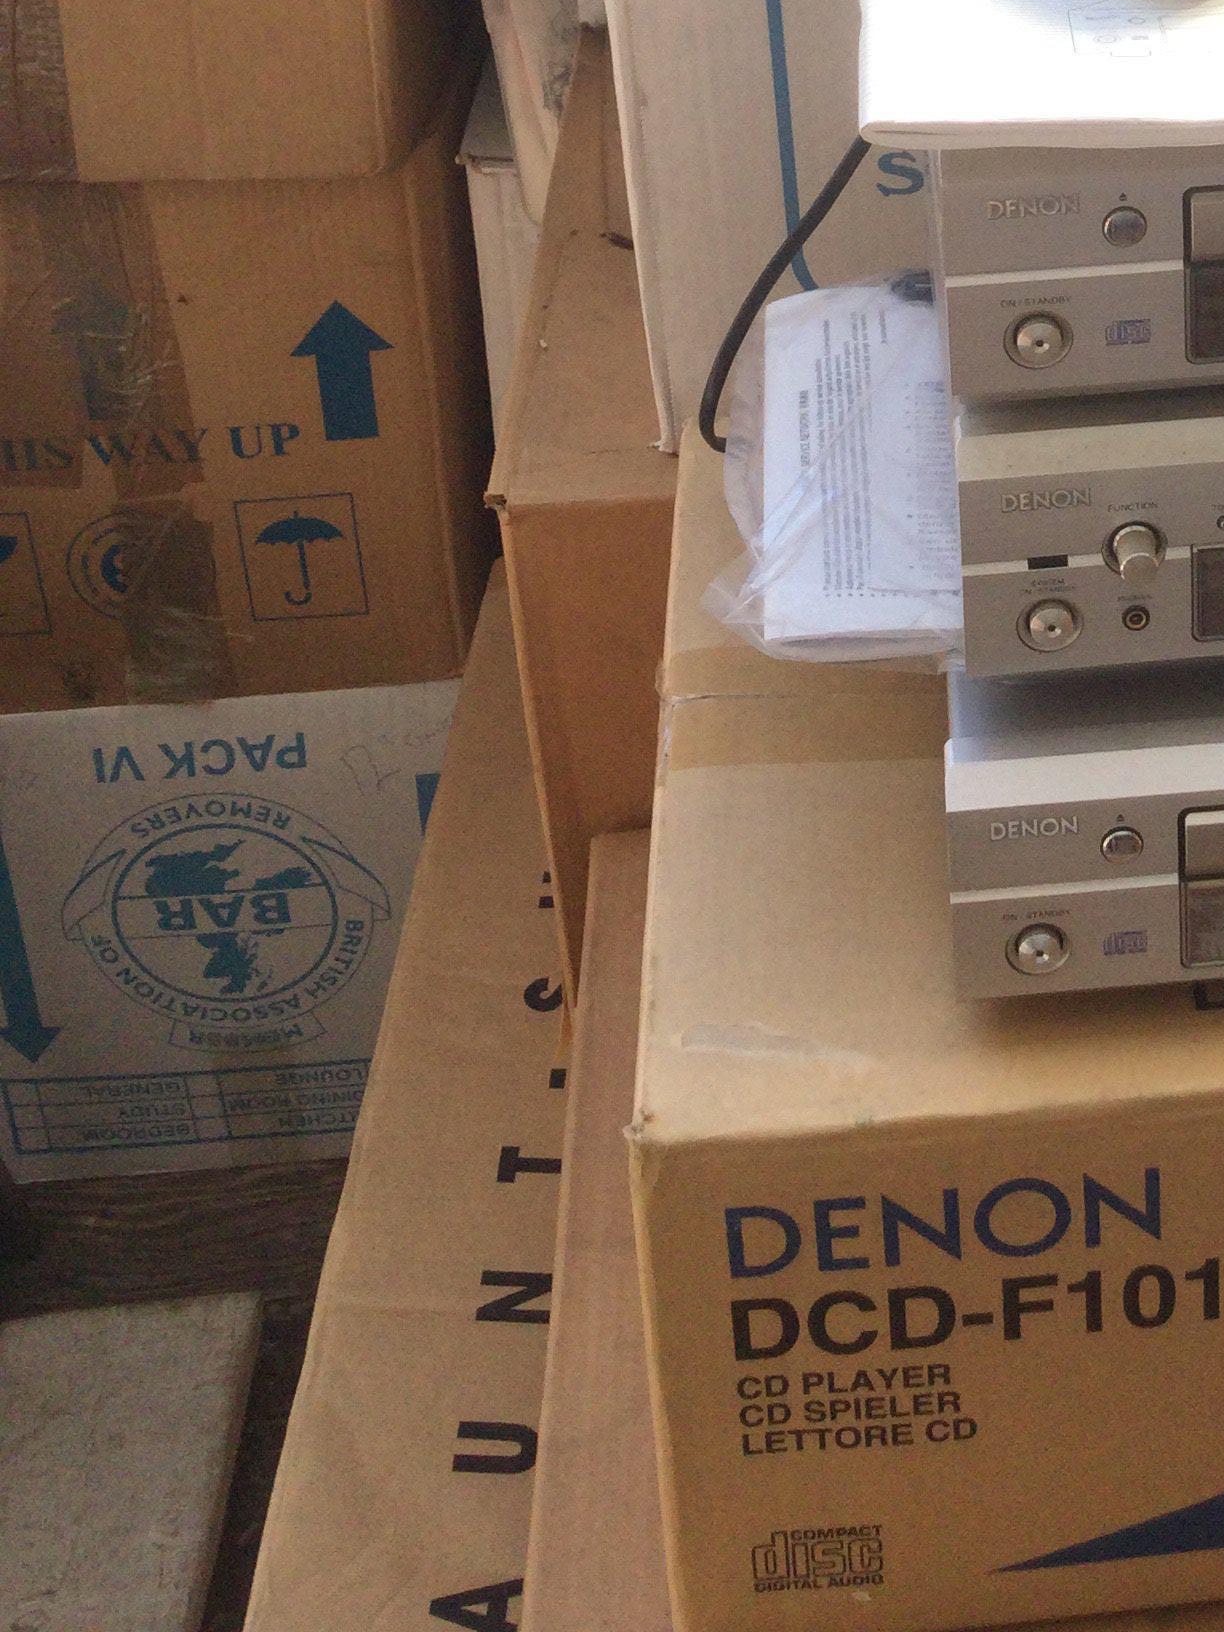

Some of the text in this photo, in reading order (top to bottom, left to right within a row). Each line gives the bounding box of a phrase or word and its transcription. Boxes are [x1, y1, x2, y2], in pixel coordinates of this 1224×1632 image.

[987, 192, 1080, 221] DENON
[227, 422, 300, 460] UP
[1001, 487, 1092, 514] DENON
[91, 746, 146, 784] VI
[157, 732, 308, 780] PACK
[130, 800, 292, 839] REMOVERS
[990, 816, 1078, 841] DENON
[153, 892, 292, 932] BAR
[302, 919, 365, 1000] BRITISH
[115, 965, 302, 1023] ASSOCIATION
[724, 1168, 1162, 1279] DENON
[731, 1256, 1221, 1361] DCD-F101
[737, 1363, 951, 1401] CD PLAYER
[739, 1390, 962, 1428] CD SPIELER
[742, 1417, 978, 1457] LETTORE CD
[791, 1524, 883, 1541] COMPACT
[753, 1573, 884, 1594] DIGITAL AUDIO
